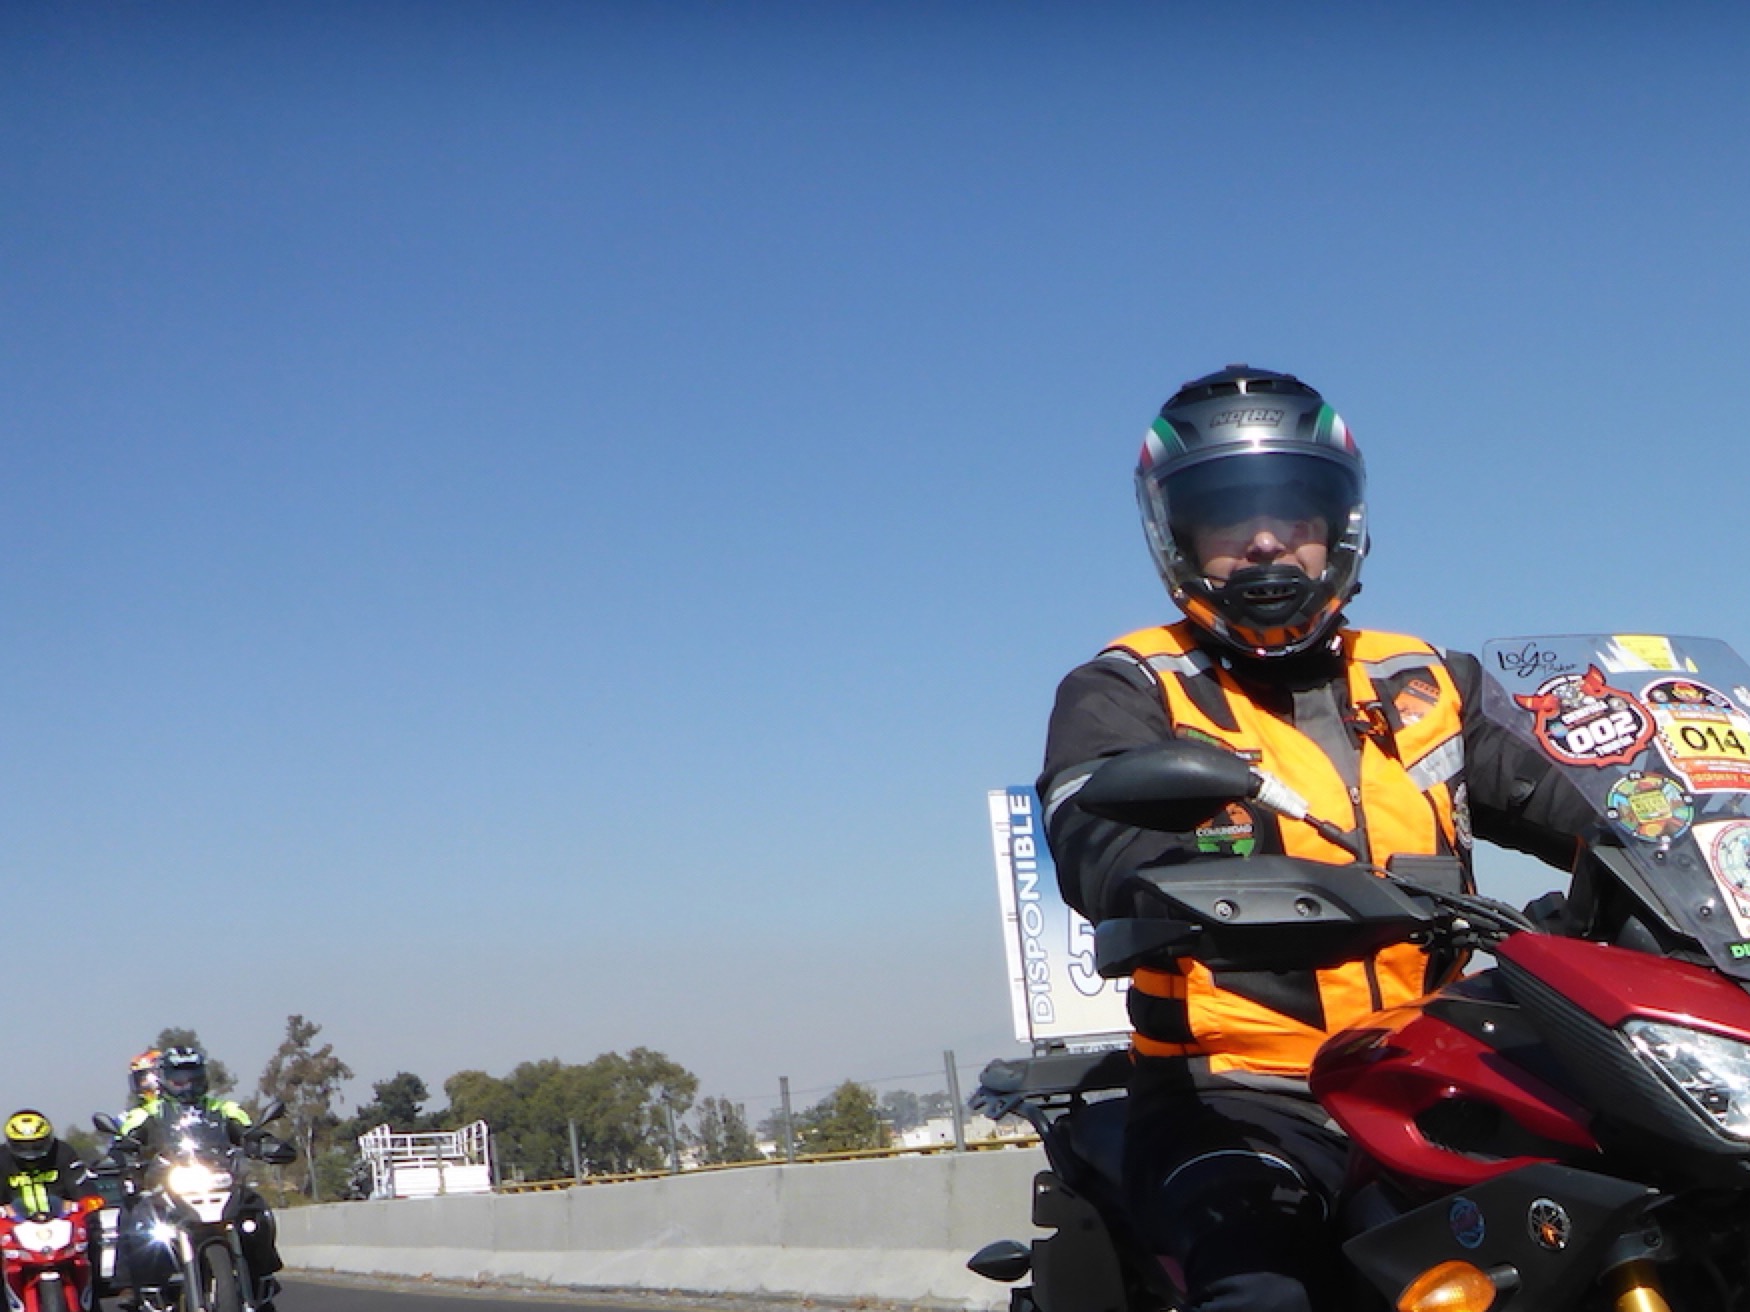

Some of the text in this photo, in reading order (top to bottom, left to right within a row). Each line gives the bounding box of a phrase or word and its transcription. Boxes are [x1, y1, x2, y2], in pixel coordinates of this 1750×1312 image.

[1566, 711, 1638, 754] 002
[1680, 725, 1746, 755] 014
[1009, 794, 1055, 1025] DISPONIBLE
